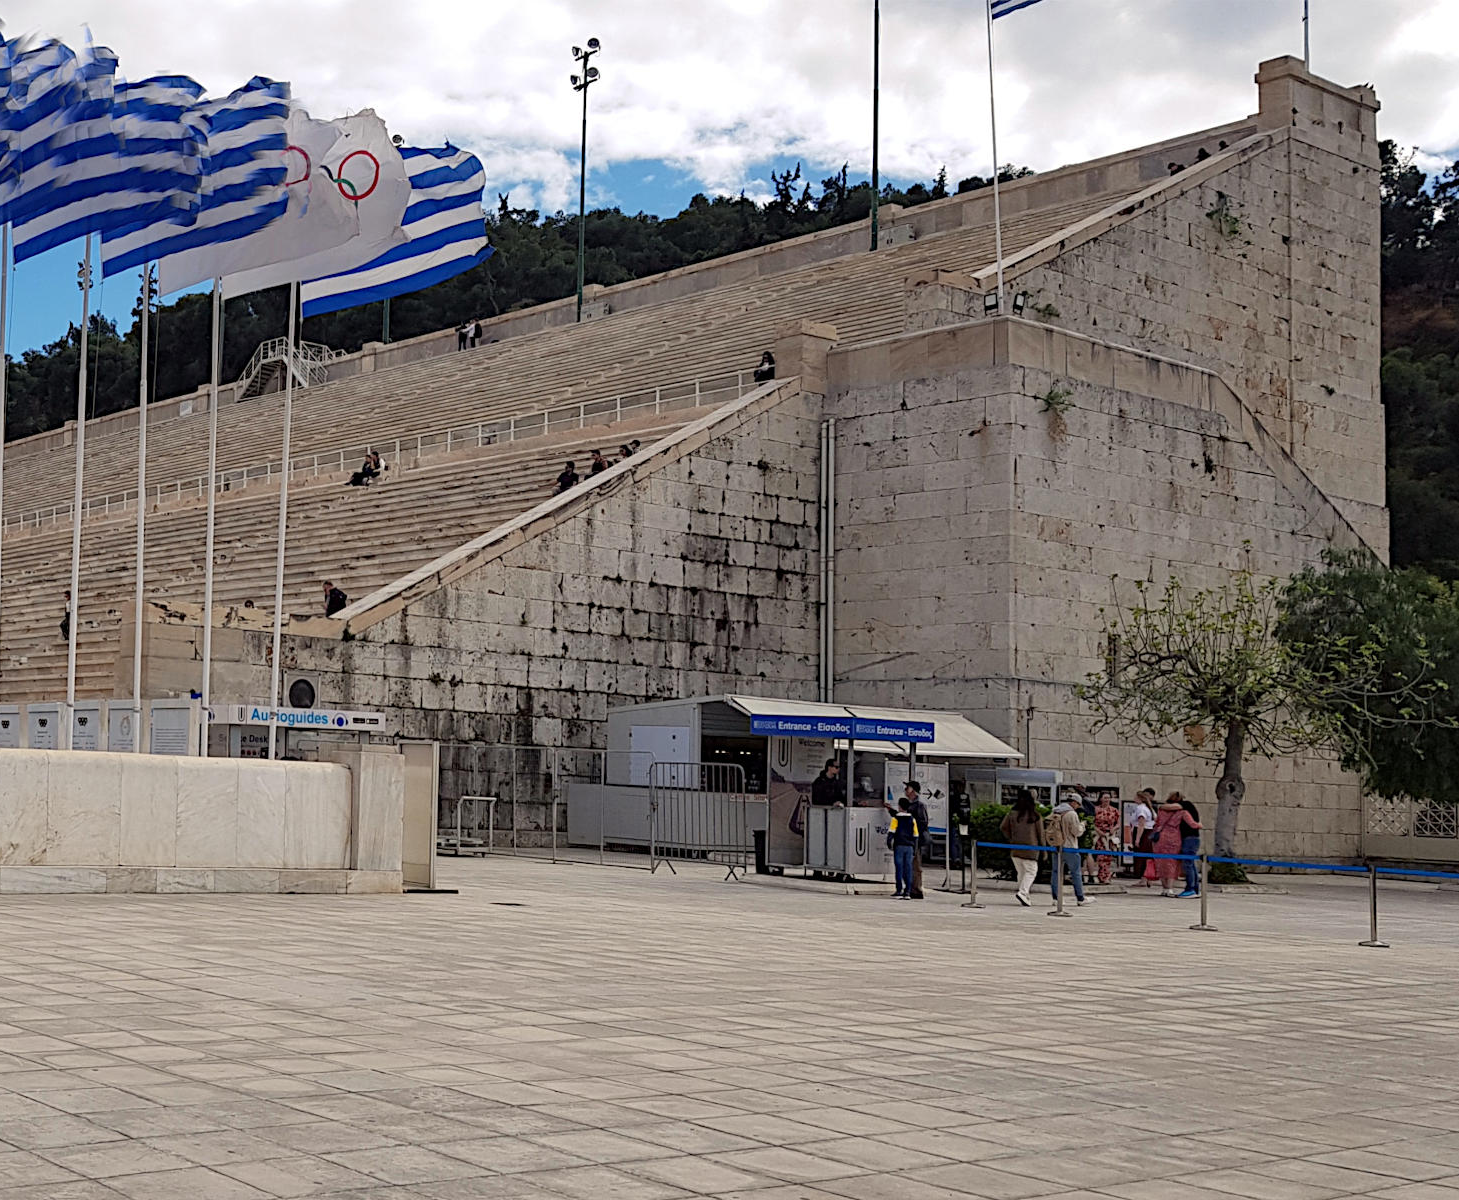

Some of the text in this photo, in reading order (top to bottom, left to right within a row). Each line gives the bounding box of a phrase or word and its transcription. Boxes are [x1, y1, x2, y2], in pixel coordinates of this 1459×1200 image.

[251, 708, 329, 726] Auioguides
[778, 721, 812, 731] Entrance
[876, 725, 904, 736] Entrance
